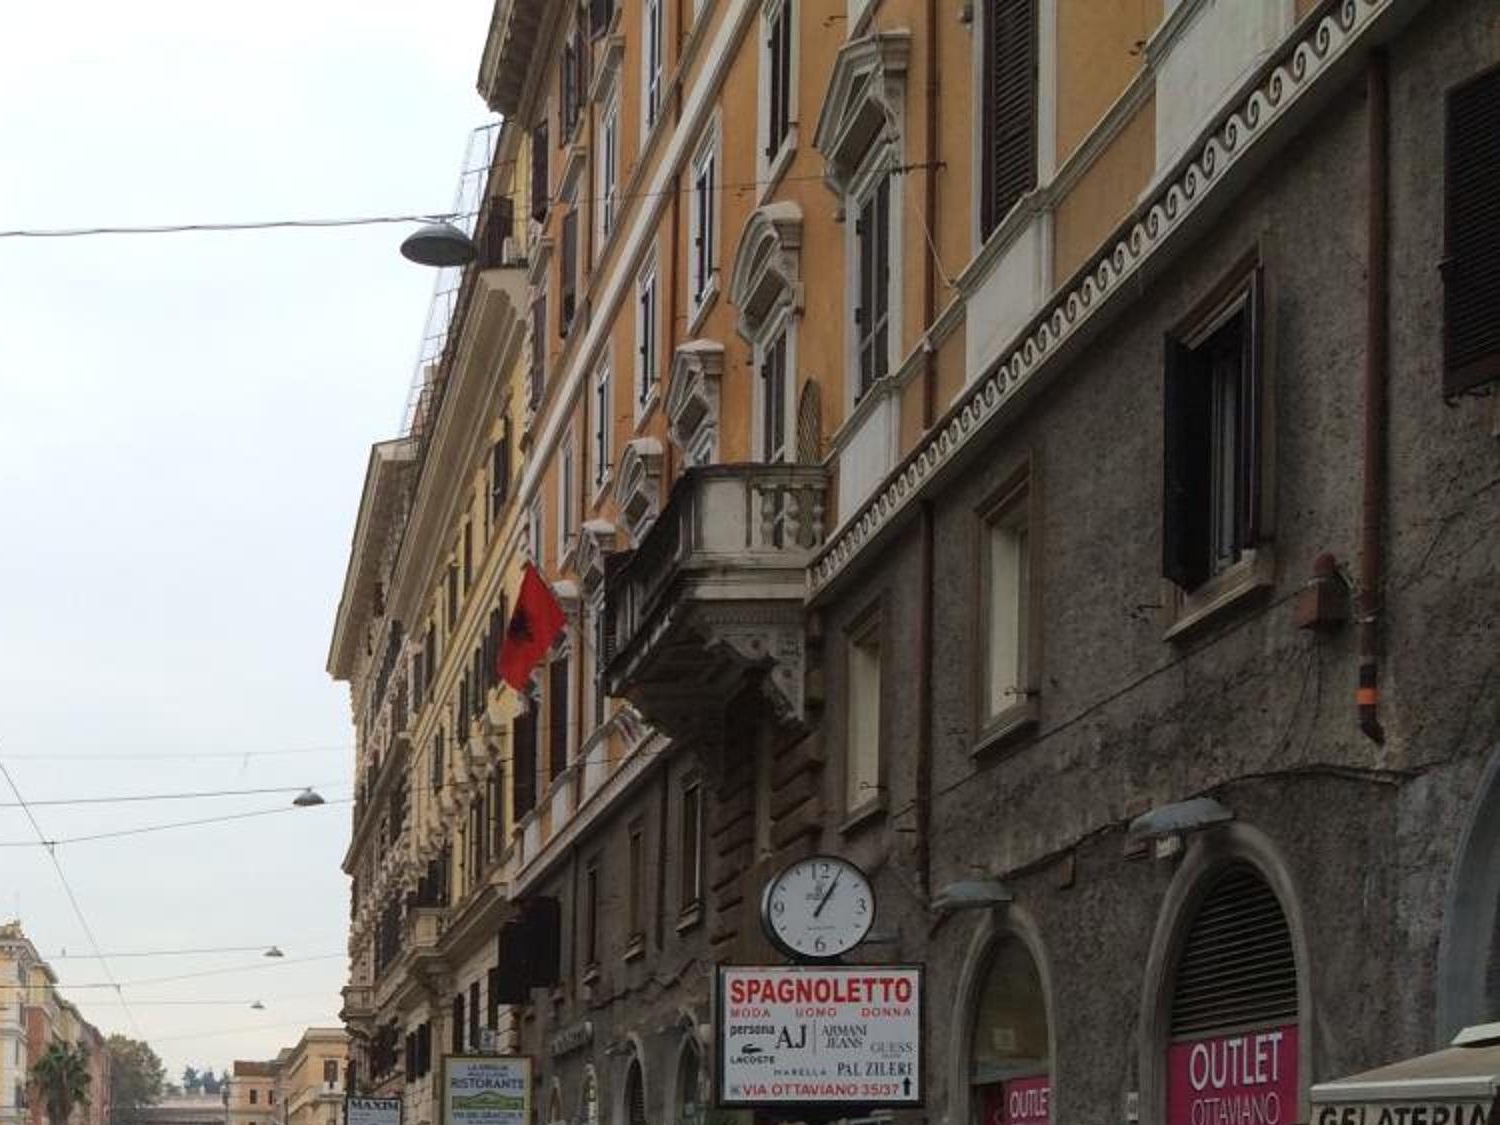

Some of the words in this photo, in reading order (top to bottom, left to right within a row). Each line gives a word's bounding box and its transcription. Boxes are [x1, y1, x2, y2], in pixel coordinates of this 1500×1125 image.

[730, 977, 912, 1003] SPAGNOLETTO
[730, 1007, 771, 1018] MODA
[795, 1007, 837, 1018] UOMO
[861, 1007, 911, 1017] DONNA
[730, 1024, 775, 1037] persona
[775, 1024, 807, 1049] AJ
[821, 1024, 867, 1037] ARMANI
[826, 1036, 863, 1049] JEANS
[870, 1041, 913, 1053] GUESS
[730, 1055, 775, 1065] LACOSTE
[1189, 1031, 1282, 1091] OUTLET
[774, 1068, 827, 1077] MARELLA
[837, 1062, 863, 1076] PAL
[865, 1061, 913, 1076] ZILERI
[742, 1084, 767, 1096] VIA
[771, 1084, 858, 1096] OTTAVIANO
[860, 1083, 899, 1095] 35/37
[350, 1100, 399, 1110] MAXIM
